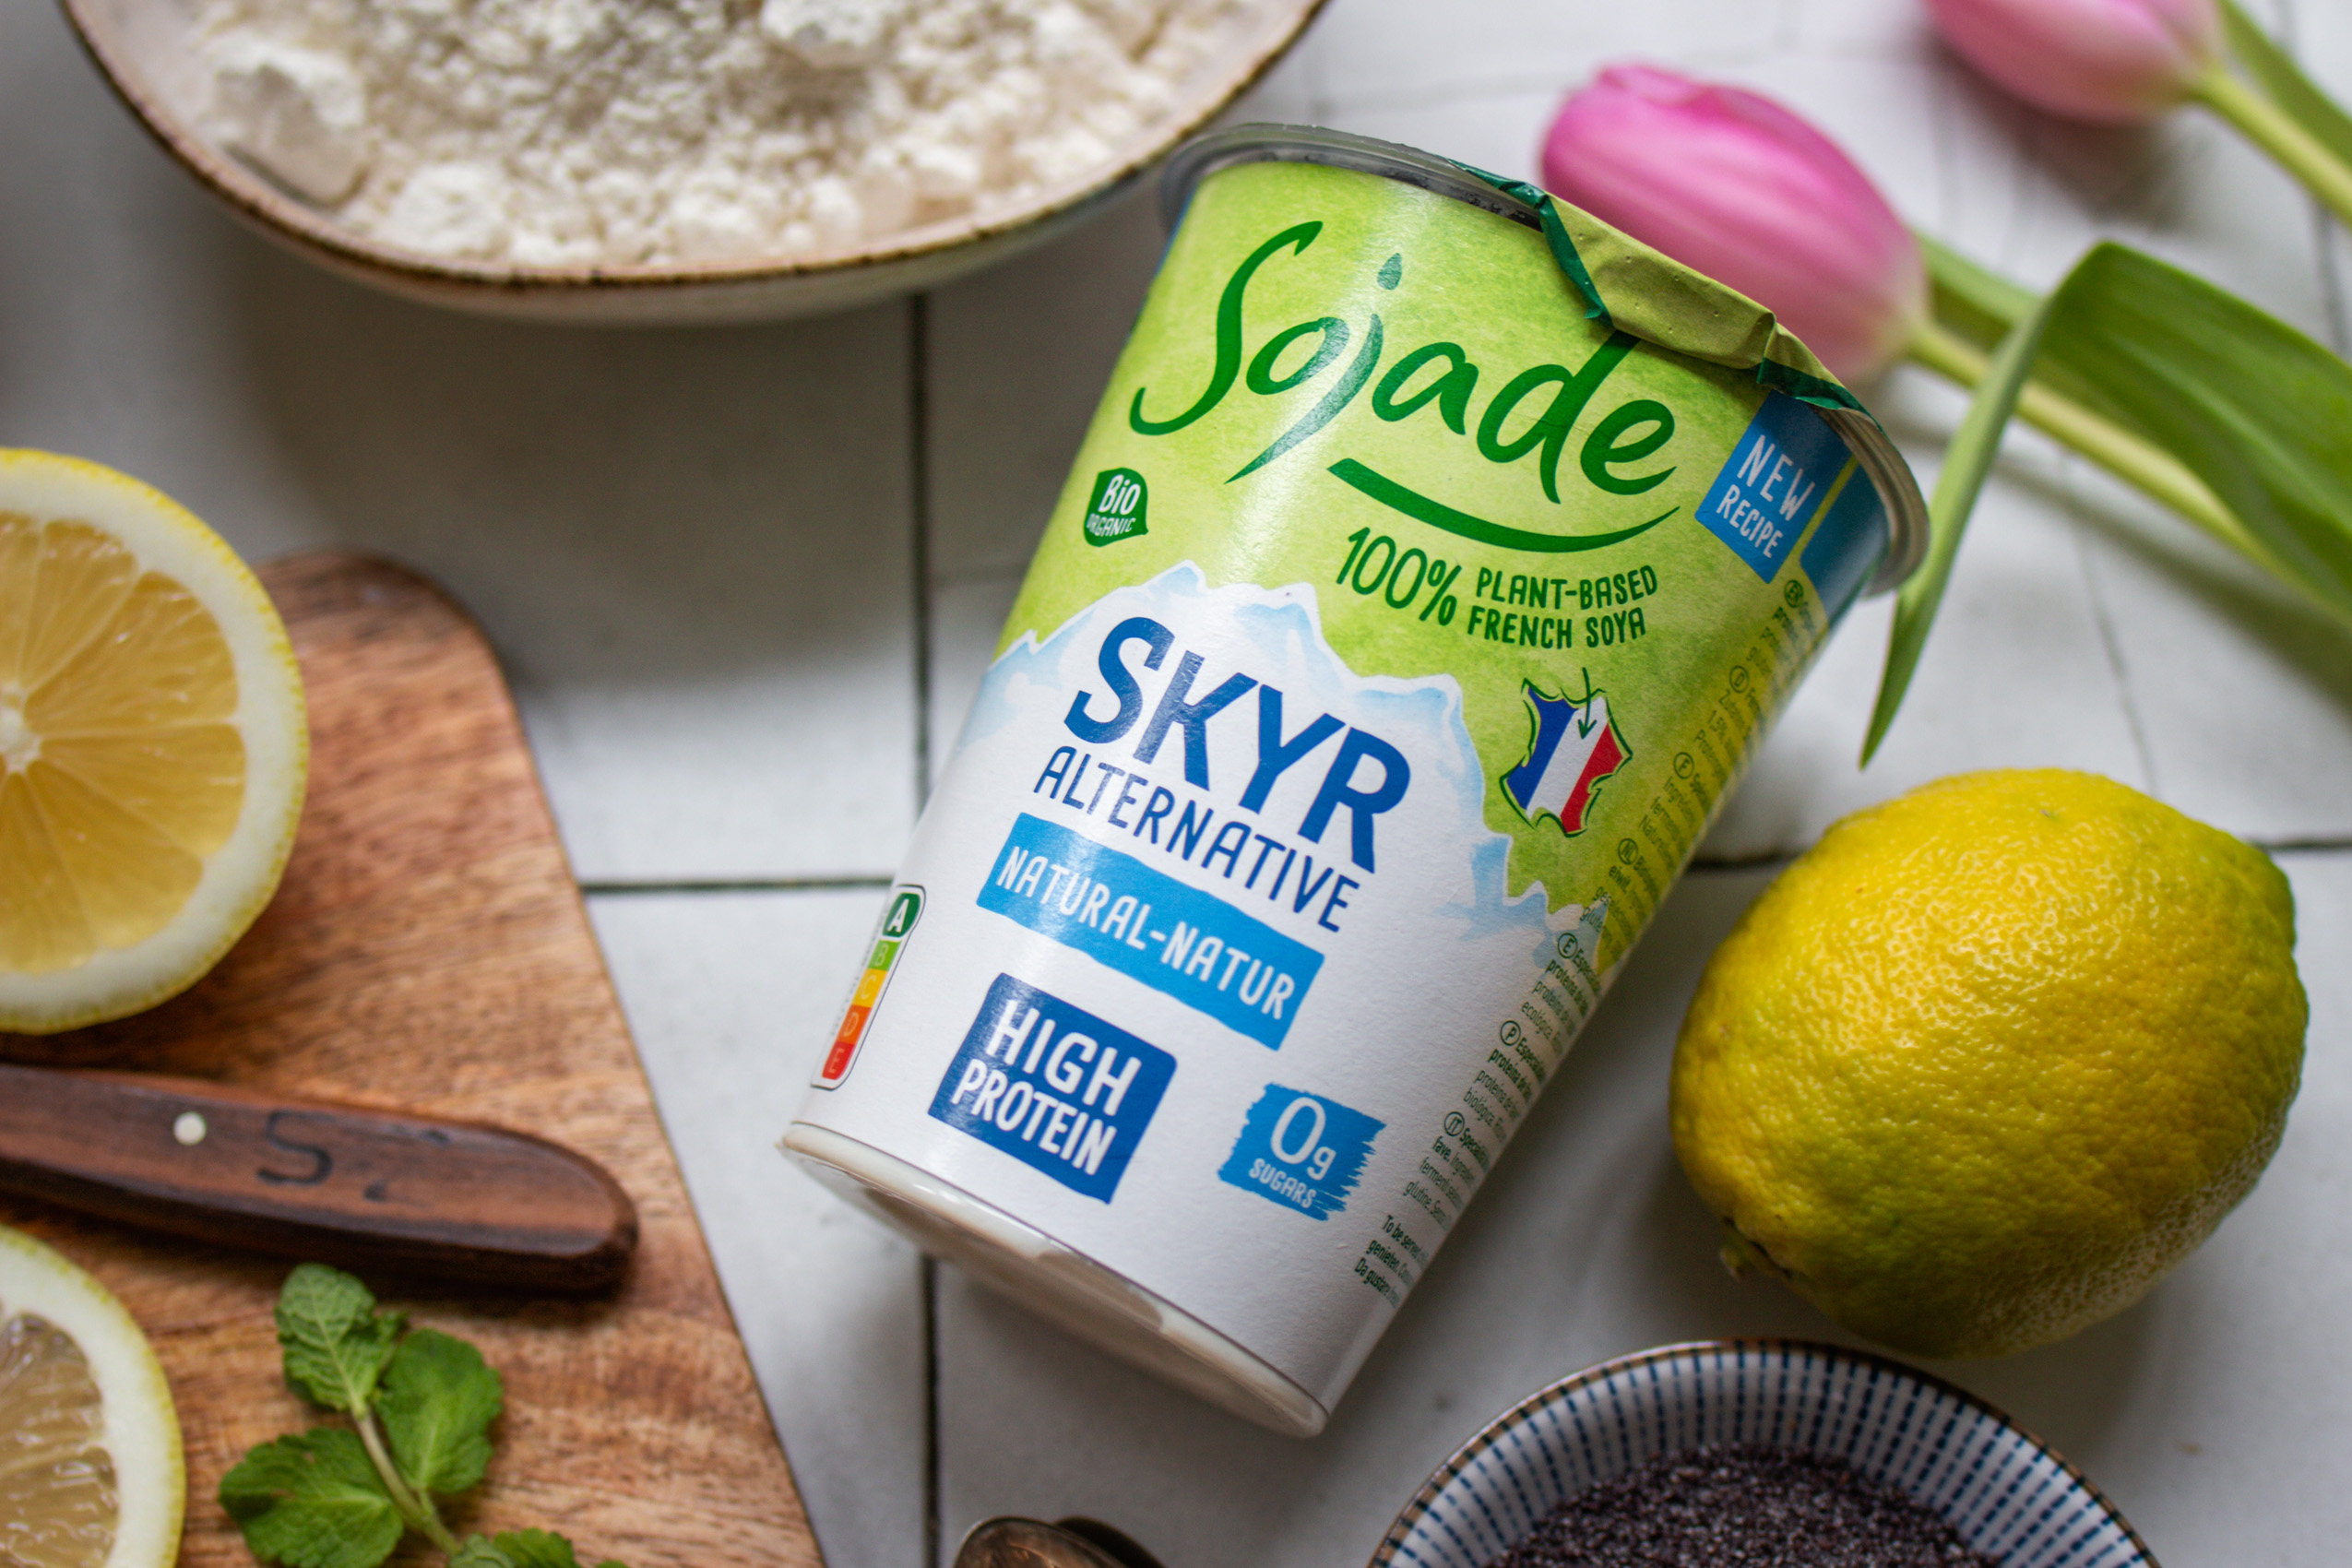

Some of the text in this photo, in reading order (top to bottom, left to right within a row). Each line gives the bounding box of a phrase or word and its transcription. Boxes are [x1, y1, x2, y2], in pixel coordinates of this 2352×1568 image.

[1130, 220, 1677, 505] Sojade
[1737, 434, 1815, 521] NEW
[1087, 514, 1136, 537] ORGANIC
[1716, 484, 1783, 558] RECIPE
[1336, 527, 1657, 625] 100% PLANT-BASED
[1467, 605, 1645, 649] FRENCH SOYA
[1063, 616, 1411, 873] SKYR
[1032, 745, 1360, 932] ALTERNATIVE
[887, 898, 909, 932] A
[995, 846, 1296, 1019] NATURAL-NATUR
[875, 944, 889, 967] B
[861, 975, 876, 999] C
[843, 1013, 859, 1037] D
[829, 1048, 845, 1074] E
[986, 1000, 1142, 1116] HIGH
[951, 1058, 1117, 1176] PROTEIN
[1249, 1158, 1316, 1208] SUGARS
[1382, 1215, 1395, 1233] To
[1392, 1221, 1401, 1242] be
[1354, 1257, 1366, 1277] Da
